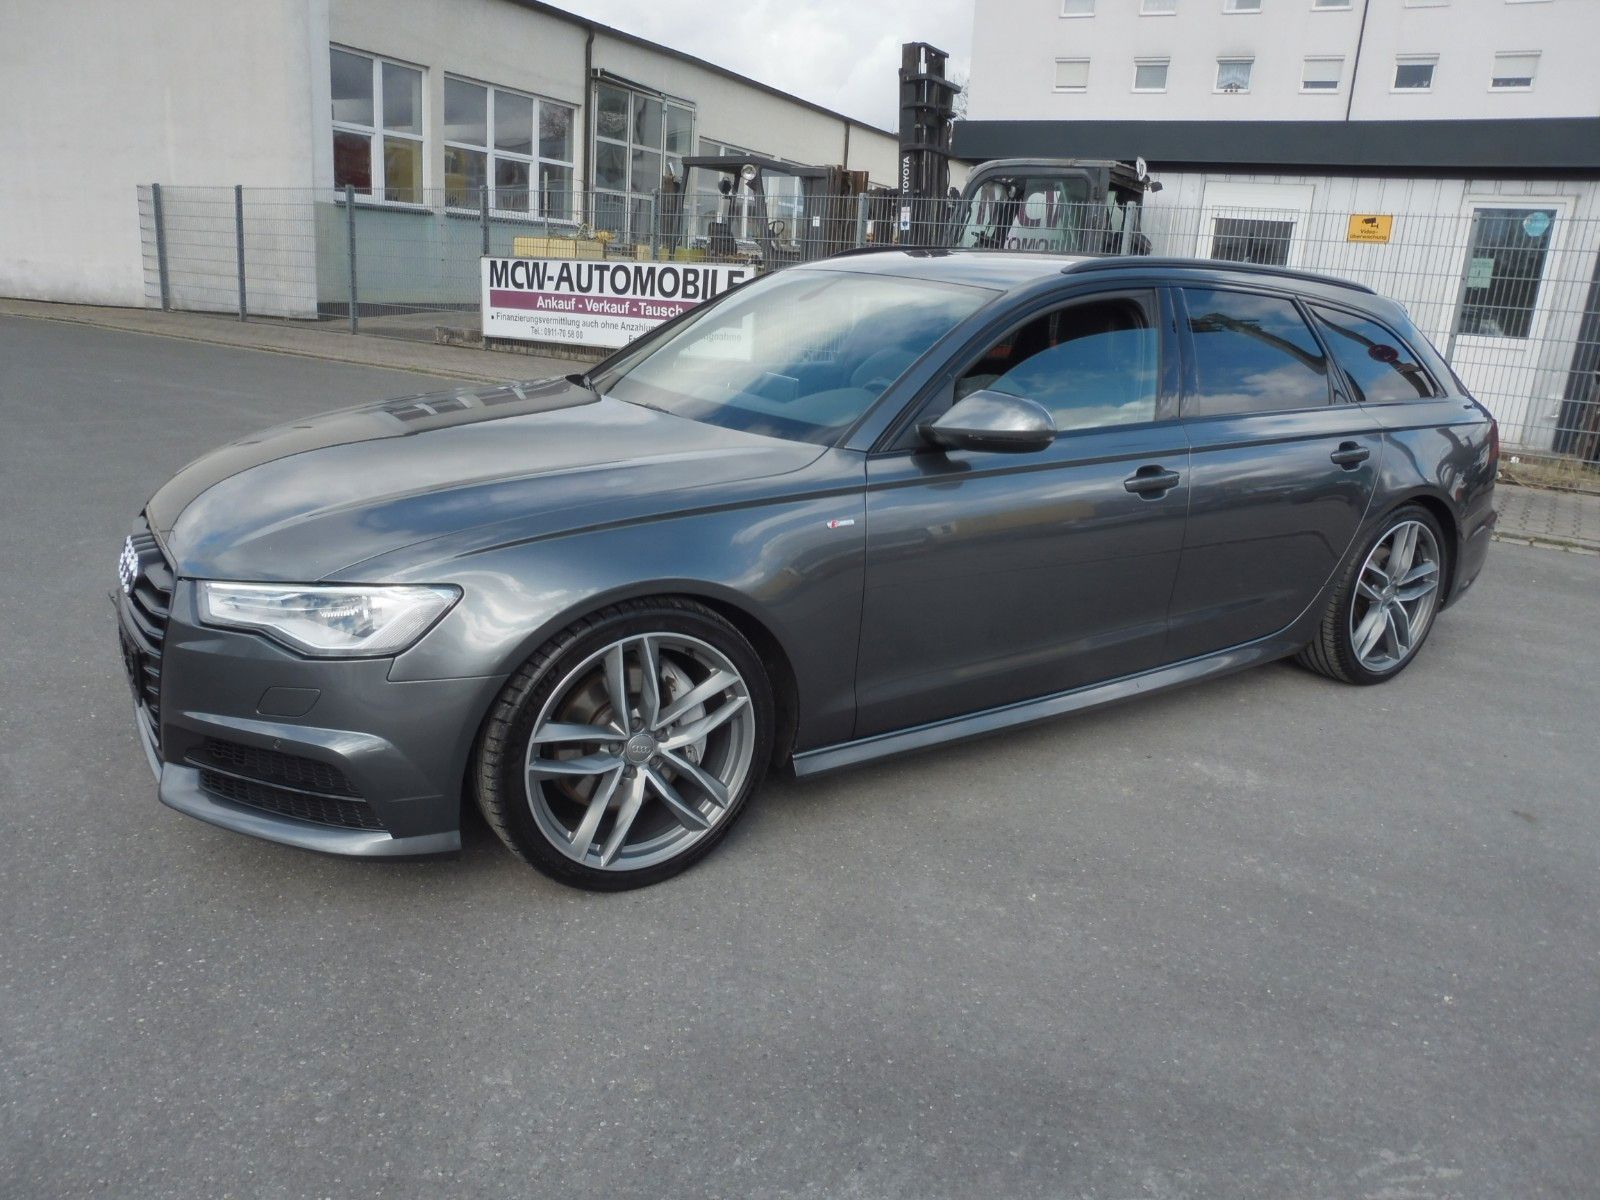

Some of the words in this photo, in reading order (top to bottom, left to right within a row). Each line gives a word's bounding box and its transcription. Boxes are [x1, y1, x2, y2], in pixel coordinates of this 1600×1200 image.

[902, 156, 910, 195] TOYOTA
[536, 295, 576, 311] Ankauf
[585, 298, 630, 315] Verkauf
[638, 301, 684, 318] Tausch
[496, 311, 580, 328] Finanzierungsvermittlung
[581, 318, 599, 329] auch
[600, 320, 619, 330] ohne
